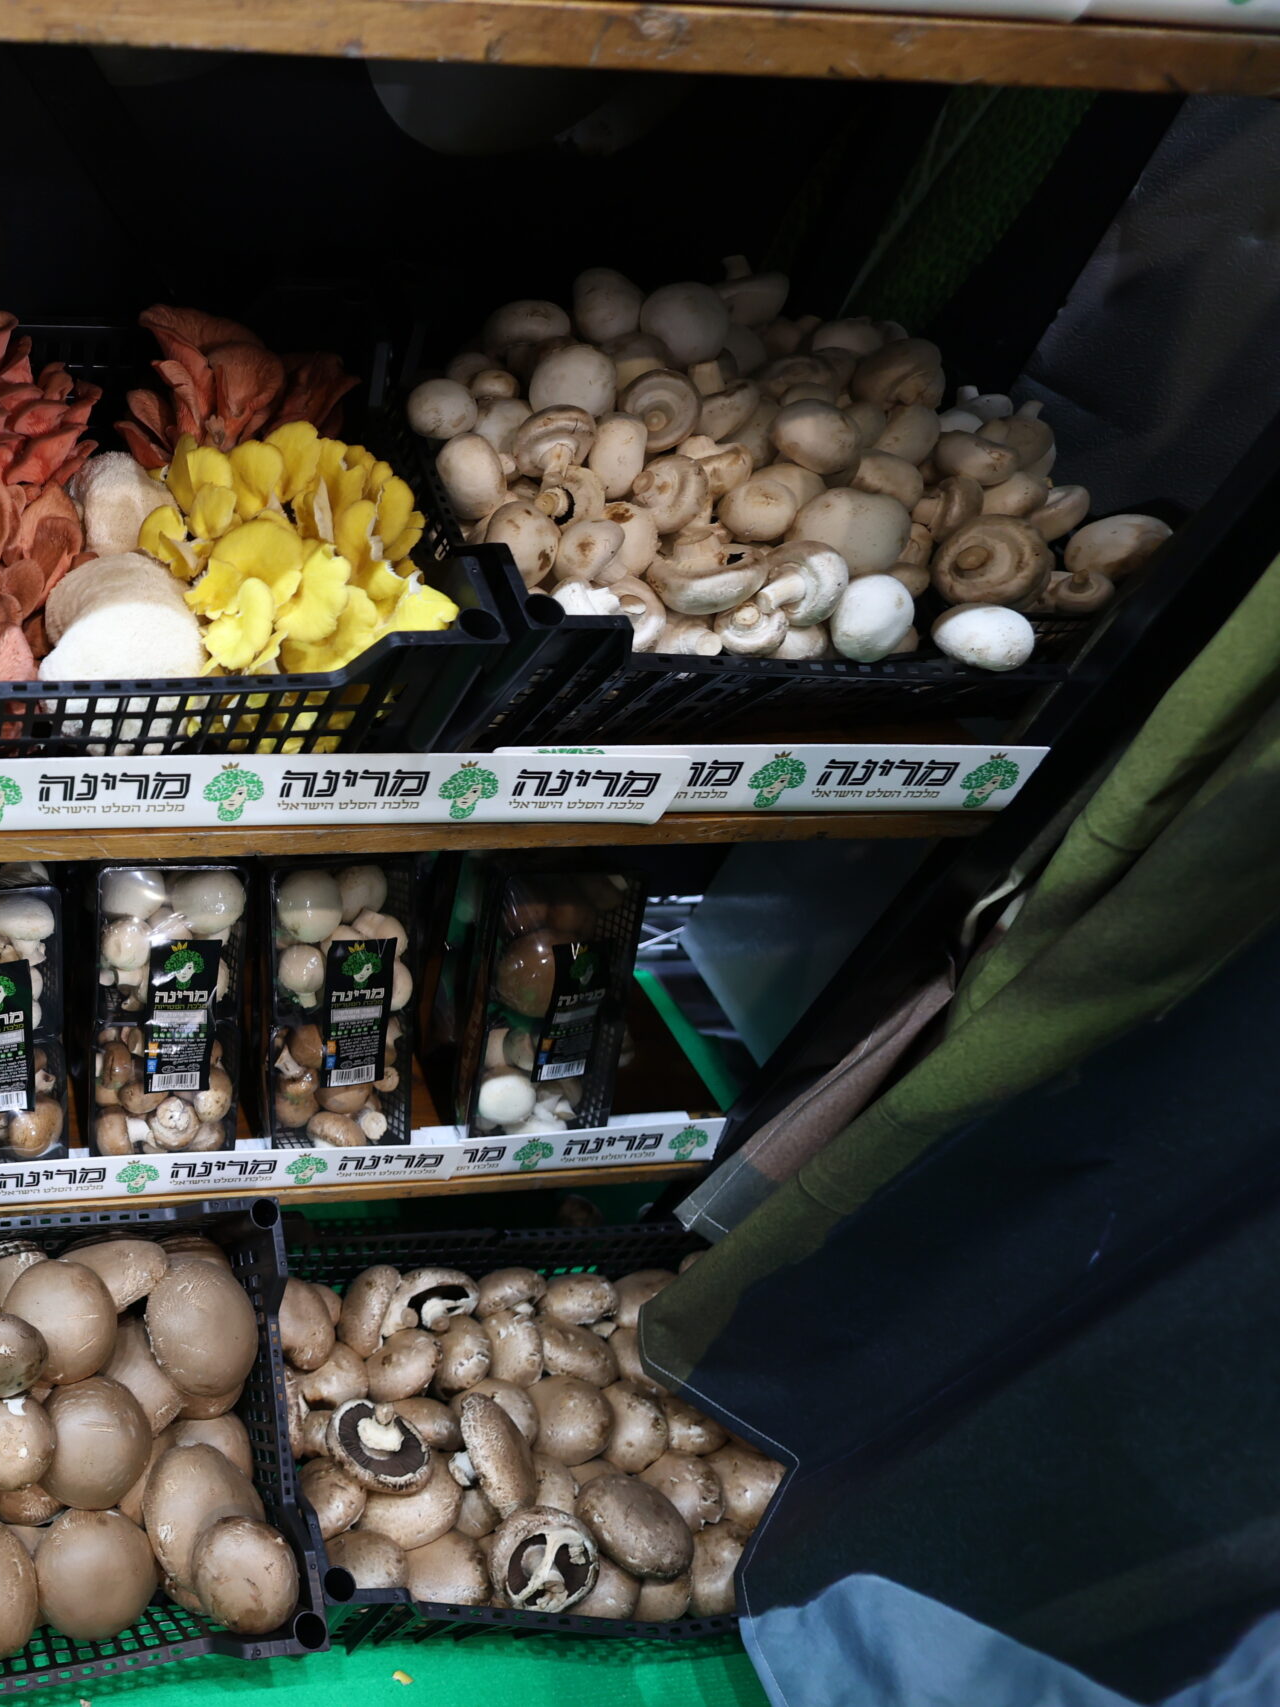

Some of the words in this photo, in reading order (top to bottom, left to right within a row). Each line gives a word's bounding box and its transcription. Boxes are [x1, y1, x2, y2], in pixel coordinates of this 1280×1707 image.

[816, 760, 960, 786] מרינה
[38, 772, 191, 801] מרינה
[280, 769, 430, 798] מרינה
[512, 769, 662, 798] מרינה
[692, 790, 728, 800] מלכת
[812, 789, 862, 799] הישראלי
[865, 790, 901, 800] הסלט
[903, 790, 940, 800] מלכת
[38, 804, 96, 815] הישראלי
[102, 803, 142, 813] הסלט
[148, 803, 185, 812] מלכת
[277, 801, 334, 811] הישראלי
[338, 800, 377, 810] הסלט
[382, 800, 419, 810] מלכת
[508, 800, 562, 811] הישראלי
[565, 800, 604, 810] הסלט
[608, 802, 644, 810] מלכת
[154, 990, 208, 1004] מרינה
[332, 988, 385, 1002] מרינה
[557, 988, 606, 1007] מרינה
[3, 1024, 24, 1032] מלכת
[563, 1133, 664, 1156] מרינה
[338, 1154, 444, 1172] מרינה
[171, 1159, 278, 1178] מרינה
